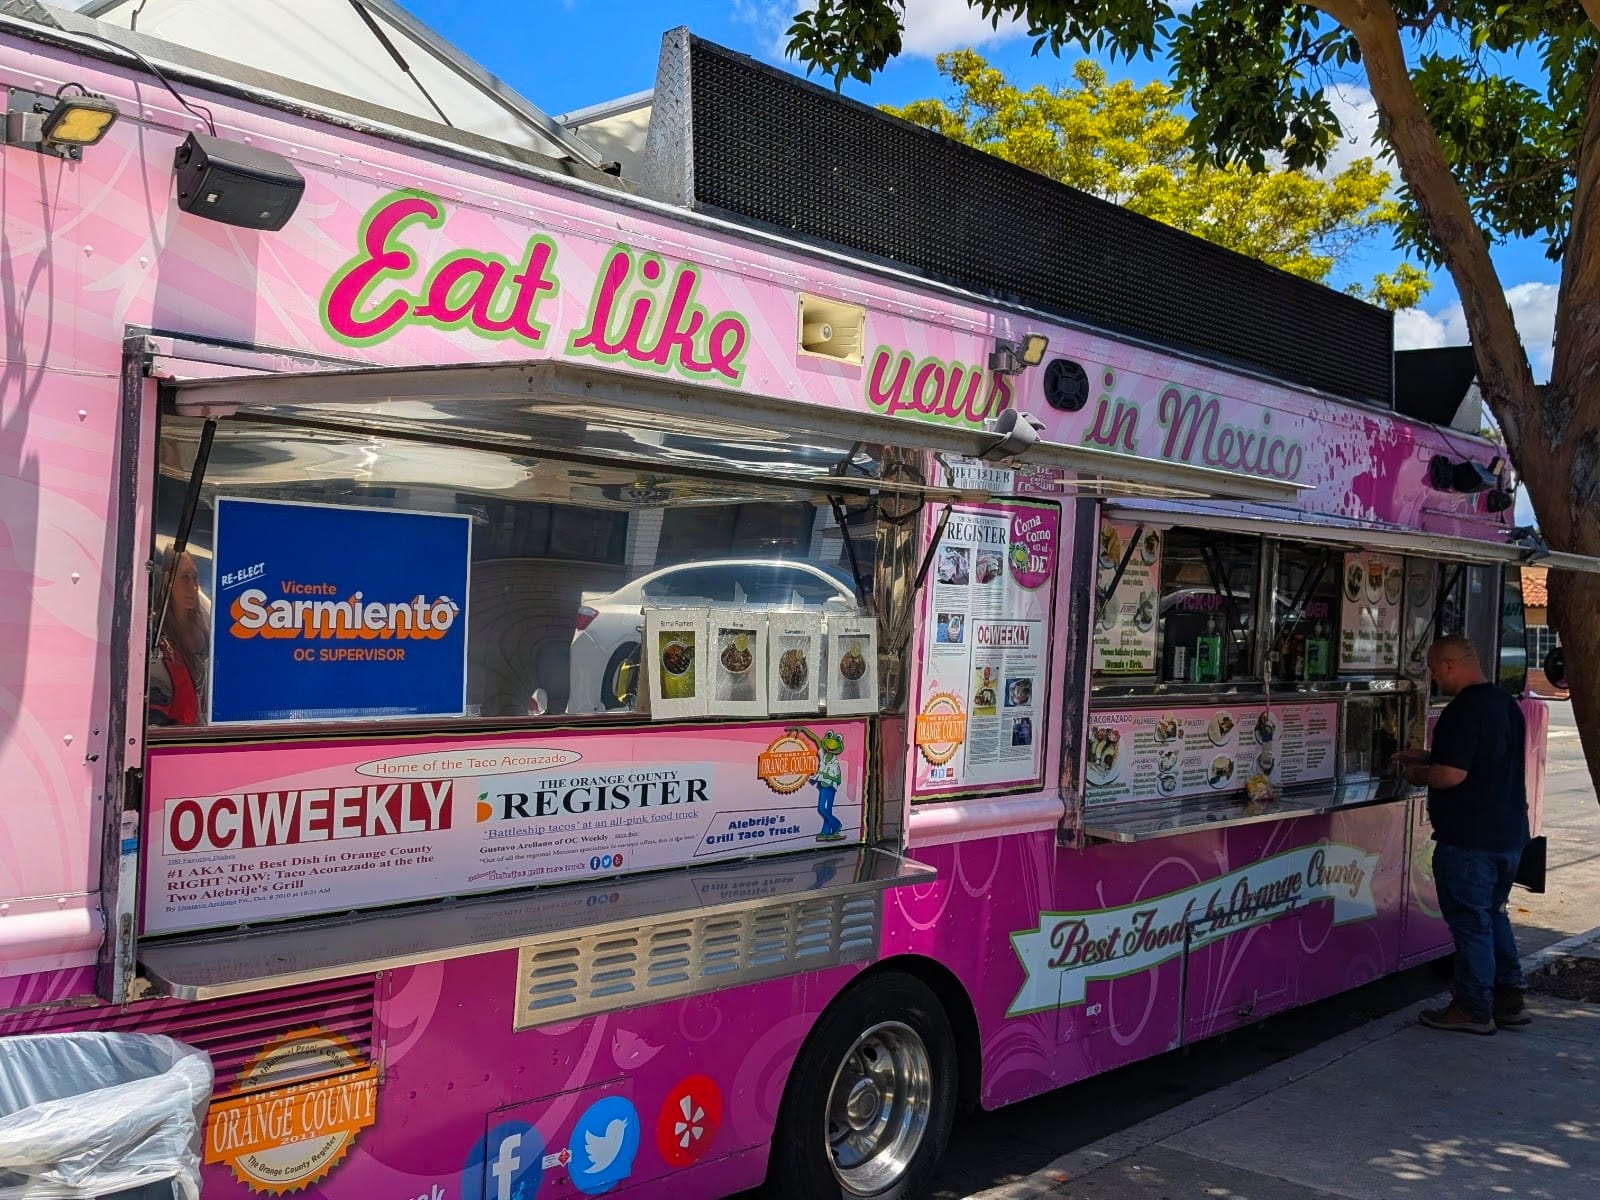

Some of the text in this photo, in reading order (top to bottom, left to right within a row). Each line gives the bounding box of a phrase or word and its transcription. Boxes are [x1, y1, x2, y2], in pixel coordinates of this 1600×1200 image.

[322, 190, 557, 347] Eat
[569, 246, 748, 385] like
[1085, 369, 1138, 452] in
[1159, 386, 1302, 480] Mexico
[946, 521, 1006, 545] REGISTER
[1014, 515, 1042, 537] Coma
[1026, 529, 1051, 543] como
[221, 562, 266, 587] RE-ELECT
[281, 581, 336, 595] Vicente
[231, 588, 459, 640] Sarmiento
[294, 648, 405, 661] OC SUPERVISOR
[376, 753, 567, 774] Home of the Taco Acorazado
[761, 757, 788, 774] ORANGE
[539, 770, 678, 790] THE ORANGE COUNTY
[497, 778, 710, 820] REGISTER
[582, 821, 592, 829] at
[595, 820, 607, 828] an
[610, 815, 648, 826] all-pink
[651, 811, 673, 822] food
[675, 809, 699, 820] truck
[728, 815, 786, 830] Alebrije's
[480, 843, 515, 854] Gustavo
[517, 840, 553, 850] Arellano
[564, 836, 579, 845] OC
[580, 833, 609, 843] Weekly
[706, 824, 801, 845] Grill Taco Truck
[167, 845, 433, 878] #1 AKA The Best Dish in Orange County
[168, 854, 434, 890] RIGHT NOW: Taco Acorazado at the the
[167, 879, 304, 903] Two Alebrije's Grill
[1048, 919, 1121, 969] Best
[1306, 850, 1366, 898] County
[213, 1078, 377, 1153] ORANGE COUNTY
[280, 1131, 317, 1145] 2011
[248, 1135, 337, 1177] The Orange County Register
